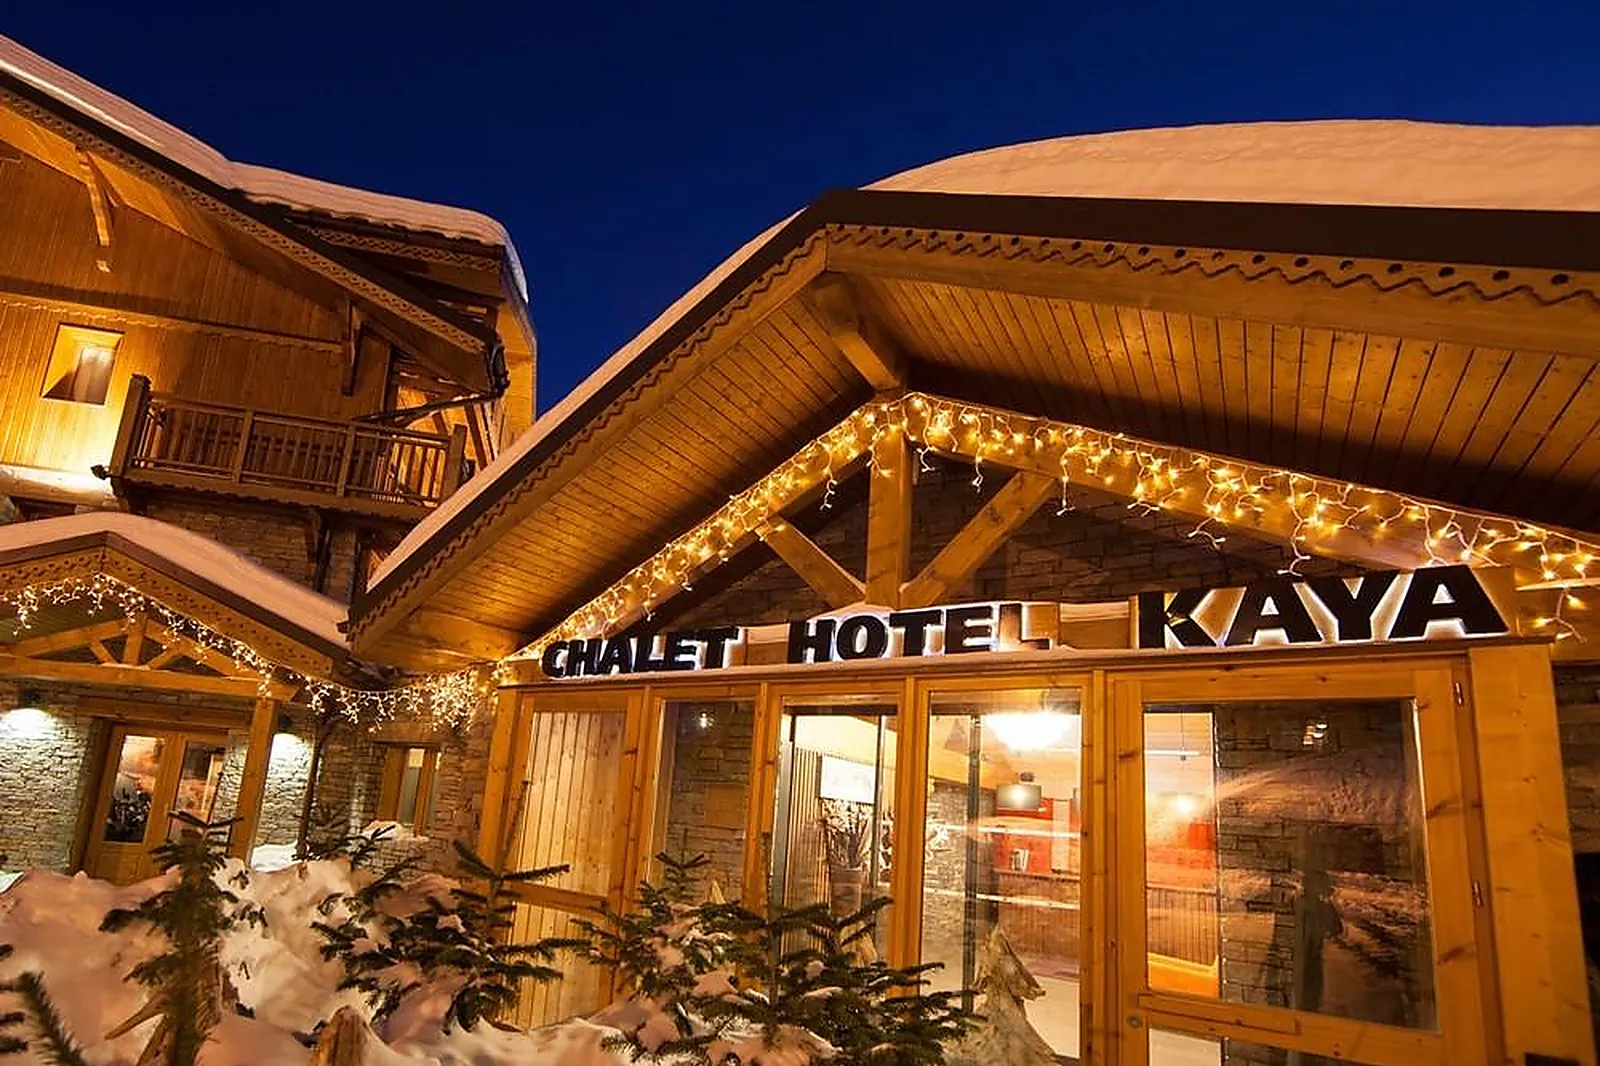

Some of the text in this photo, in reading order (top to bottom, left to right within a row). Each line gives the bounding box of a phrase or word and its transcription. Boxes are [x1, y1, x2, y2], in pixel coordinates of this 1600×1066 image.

[541, 565, 1510, 678] CHALET HOTEL KAYA
